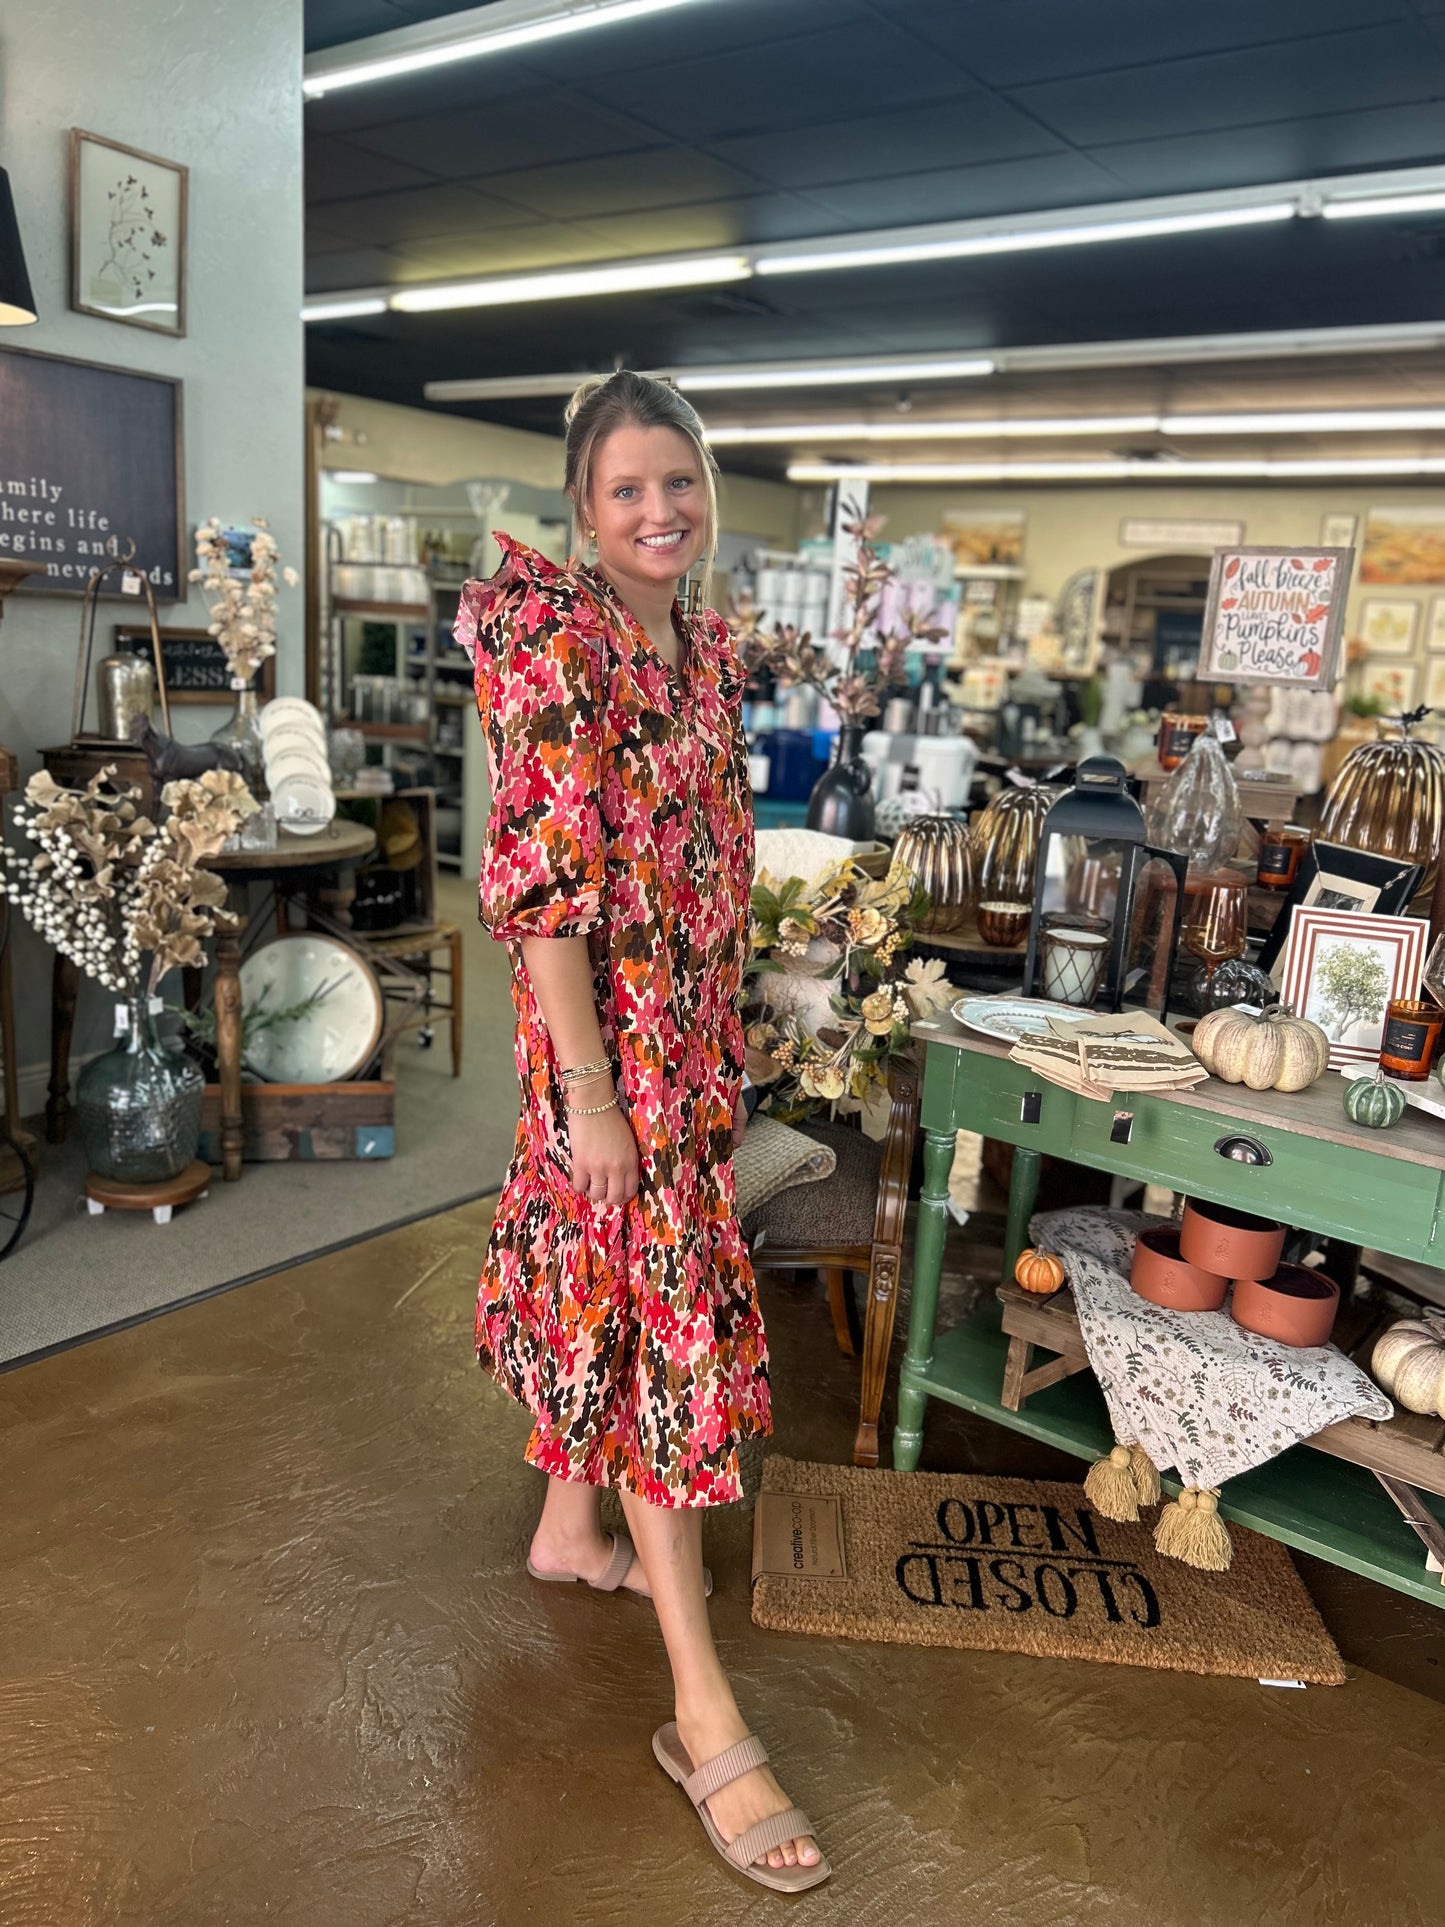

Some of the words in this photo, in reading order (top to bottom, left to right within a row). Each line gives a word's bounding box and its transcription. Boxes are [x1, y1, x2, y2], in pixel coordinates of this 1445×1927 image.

[0, 477, 63, 503] mily
[68, 508, 110, 531] life
[77, 534, 119, 558] and
[47, 562, 109, 581] neve
[1239, 560, 1270, 591] fall
[1274, 558, 1322, 590] breeze
[1237, 590, 1310, 614] AUTUMN
[1222, 612, 1319, 648] Pumpkins
[1238, 640, 1299, 669] Please
[937, 1500, 1100, 1555] OPEN
[895, 1553, 1161, 1628] CLOSED
